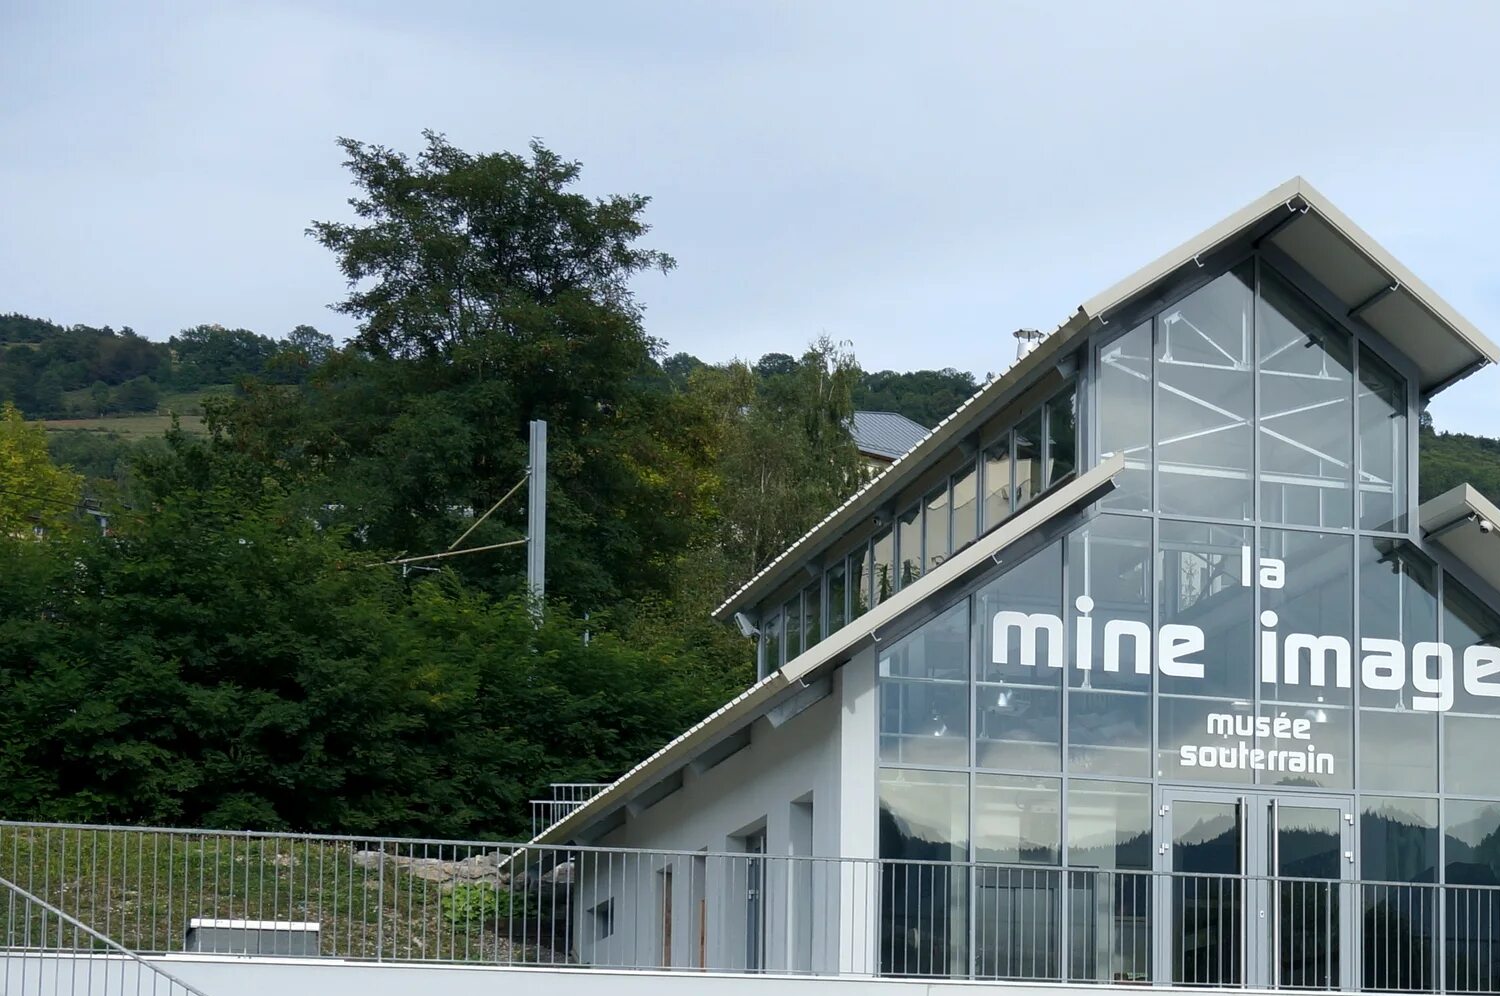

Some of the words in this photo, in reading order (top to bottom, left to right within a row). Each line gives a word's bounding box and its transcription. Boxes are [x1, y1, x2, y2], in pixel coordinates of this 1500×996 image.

[1241, 545, 1286, 590] la
[992, 595, 1206, 679] mine
[1206, 711, 1312, 740] musée
[1179, 740, 1335, 775] souterrain
